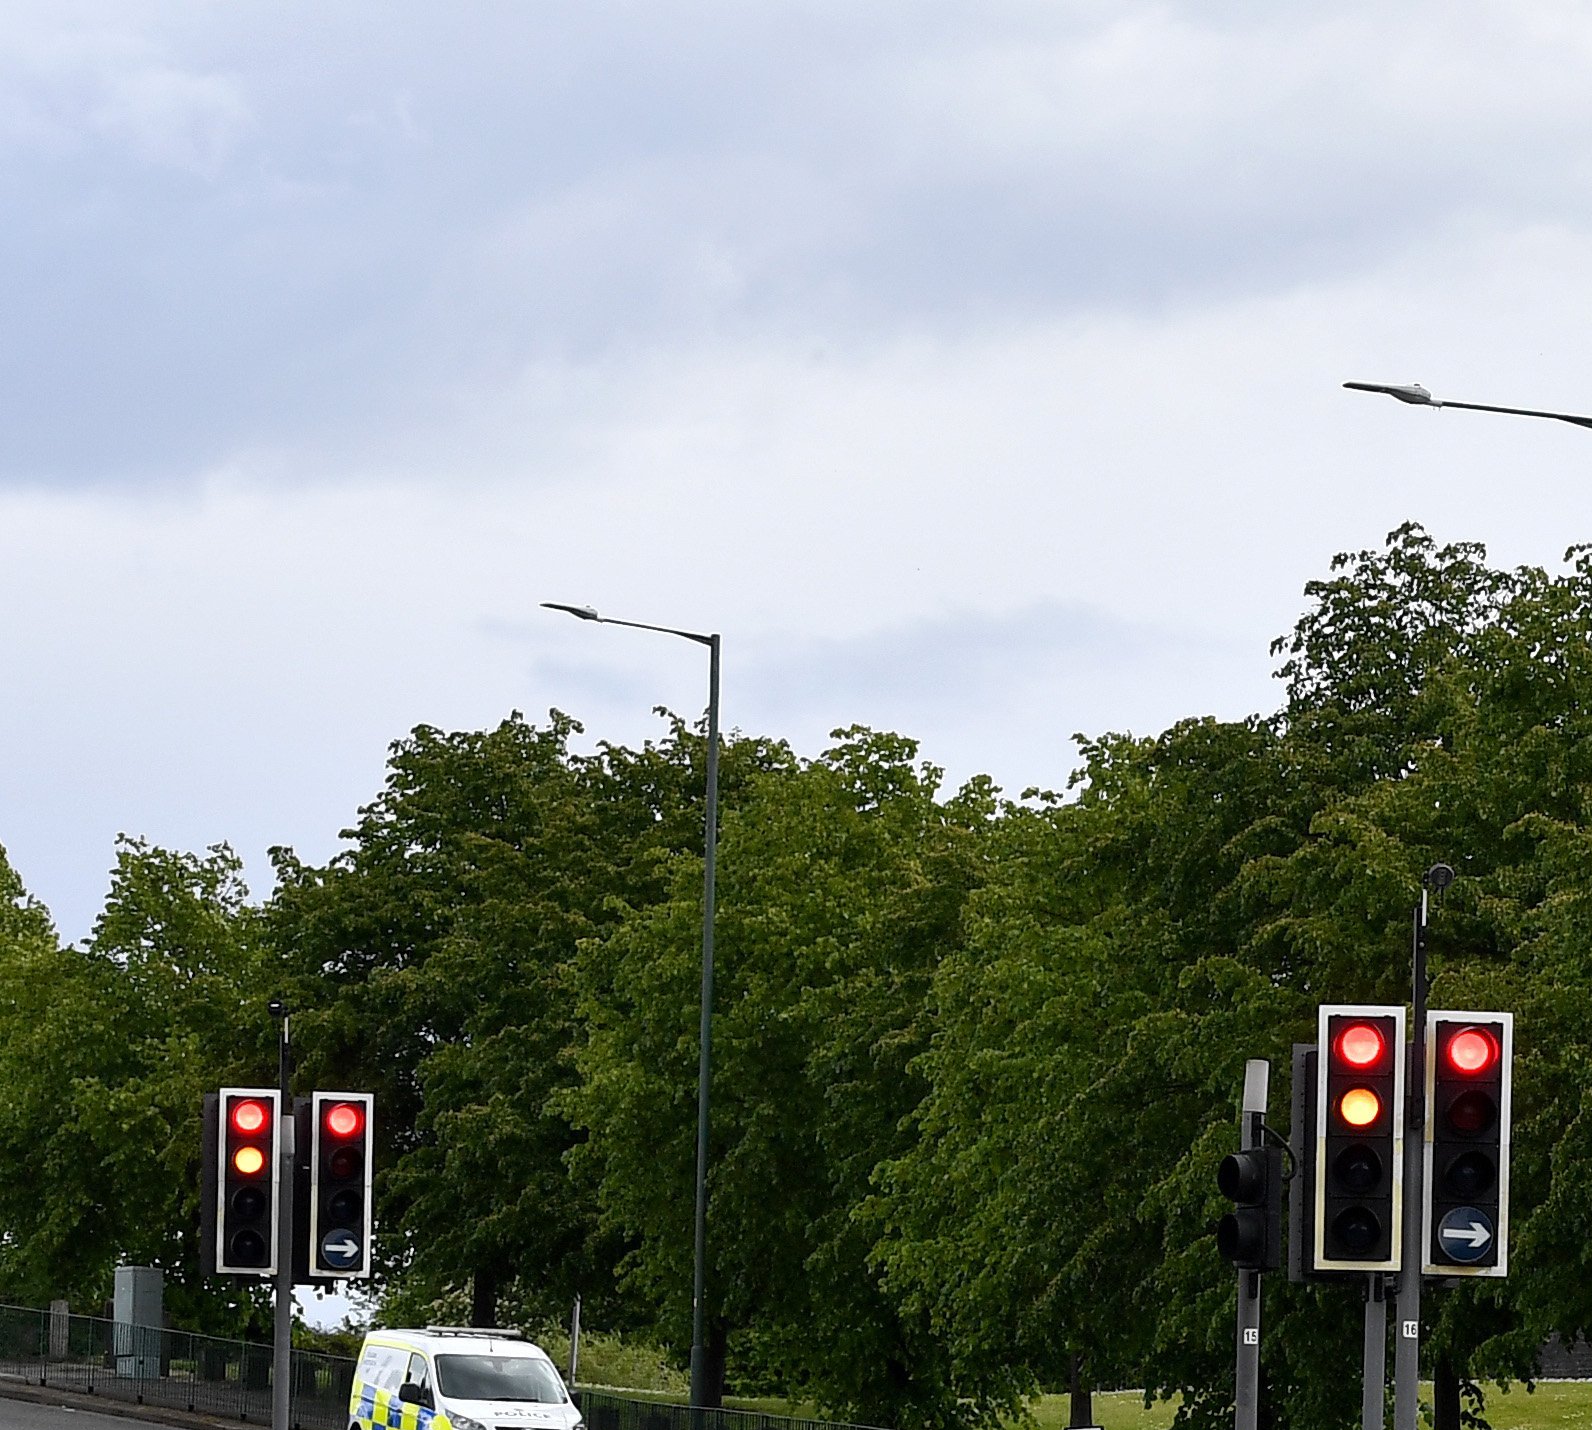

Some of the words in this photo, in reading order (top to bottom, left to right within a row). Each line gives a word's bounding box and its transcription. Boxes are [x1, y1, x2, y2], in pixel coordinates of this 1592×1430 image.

[1404, 1323, 1417, 1336] 16
[1245, 1330, 1257, 1342] 15
[494, 1409, 551, 1419] POLICE
